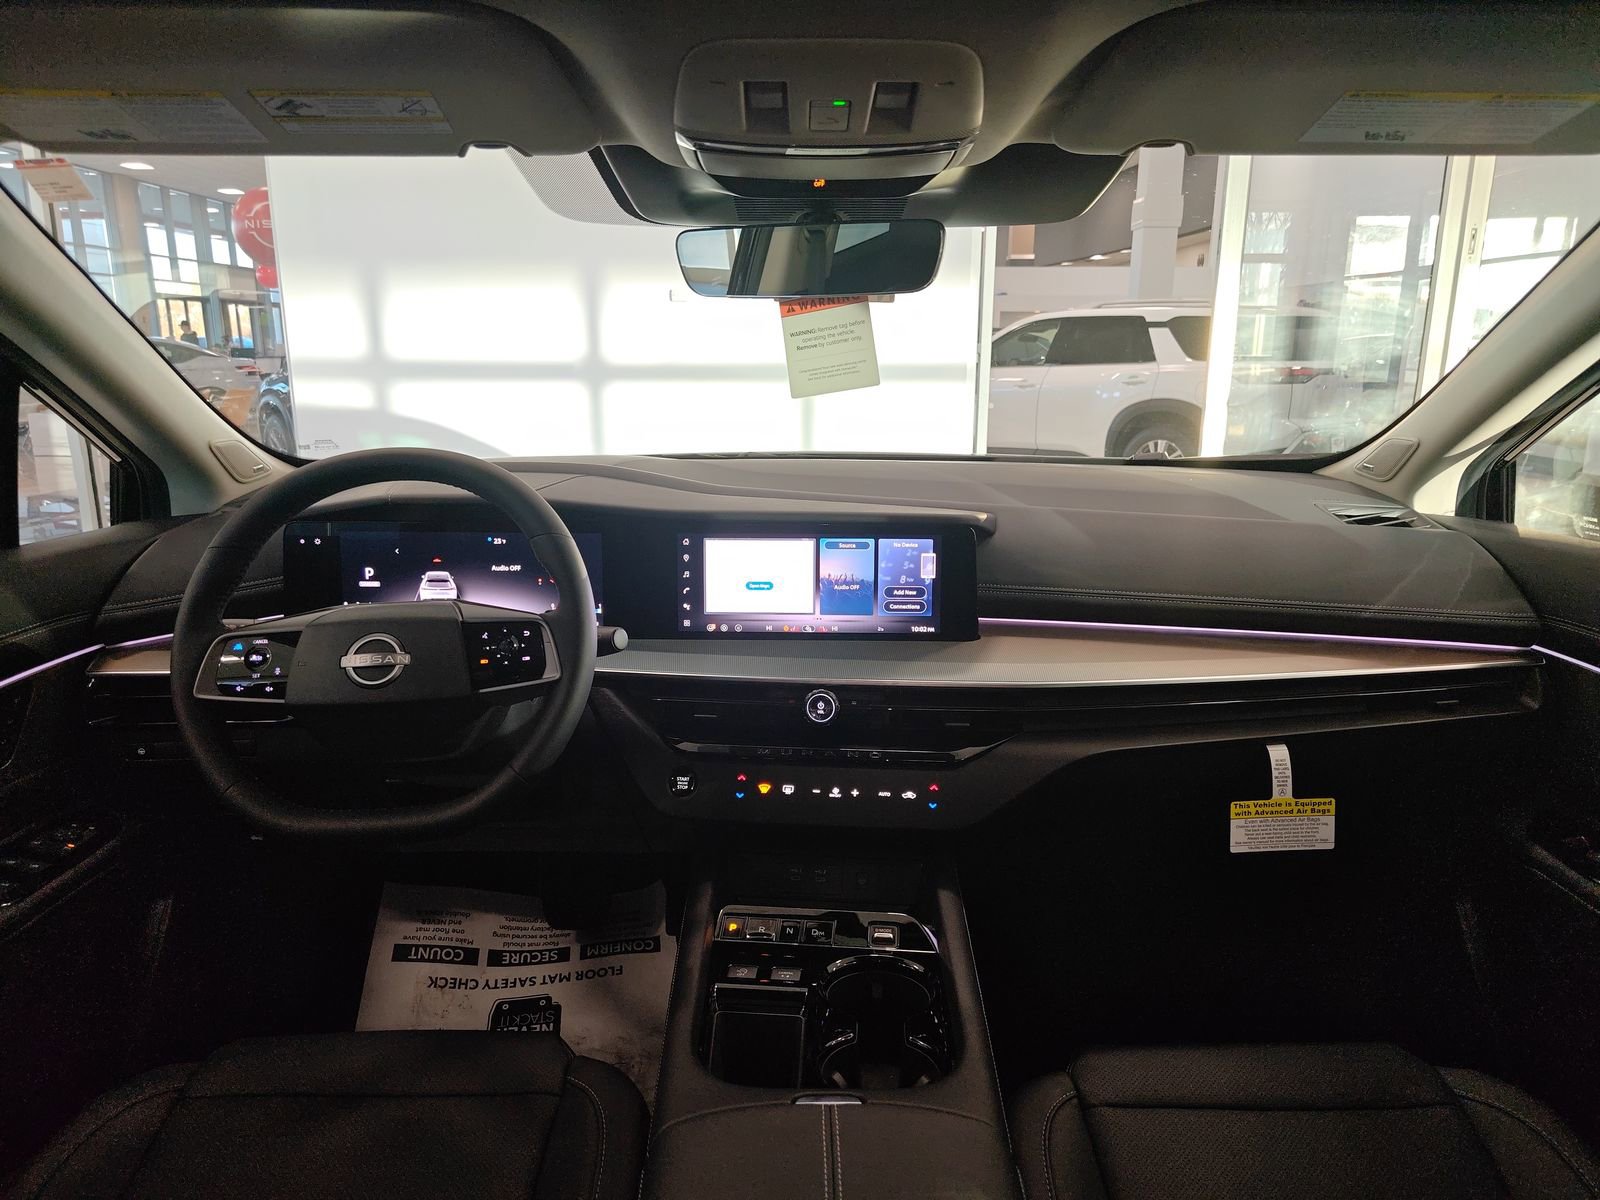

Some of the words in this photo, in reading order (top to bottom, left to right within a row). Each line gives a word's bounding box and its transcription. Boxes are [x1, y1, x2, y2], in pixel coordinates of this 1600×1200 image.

[849, 319, 865, 327] before
[796, 343, 817, 351] Remove
[826, 337, 850, 347] customer
[802, 334, 826, 344] operating
[364, 567, 374, 580] P
[343, 654, 409, 666] NISSAN
[729, 923, 738, 931] P
[456, 937, 474, 945] Make
[407, 946, 464, 961] COUNT
[587, 939, 655, 957] CONFIRM
[501, 950, 558, 964] SECURE
[540, 972, 571, 985] MAT
[575, 965, 623, 981] FLOOR
[427, 976, 479, 990] CHECK
[482, 976, 537, 990] SAFETY
[497, 1015, 510, 1028] IT
[512, 1010, 555, 1026] STACK
